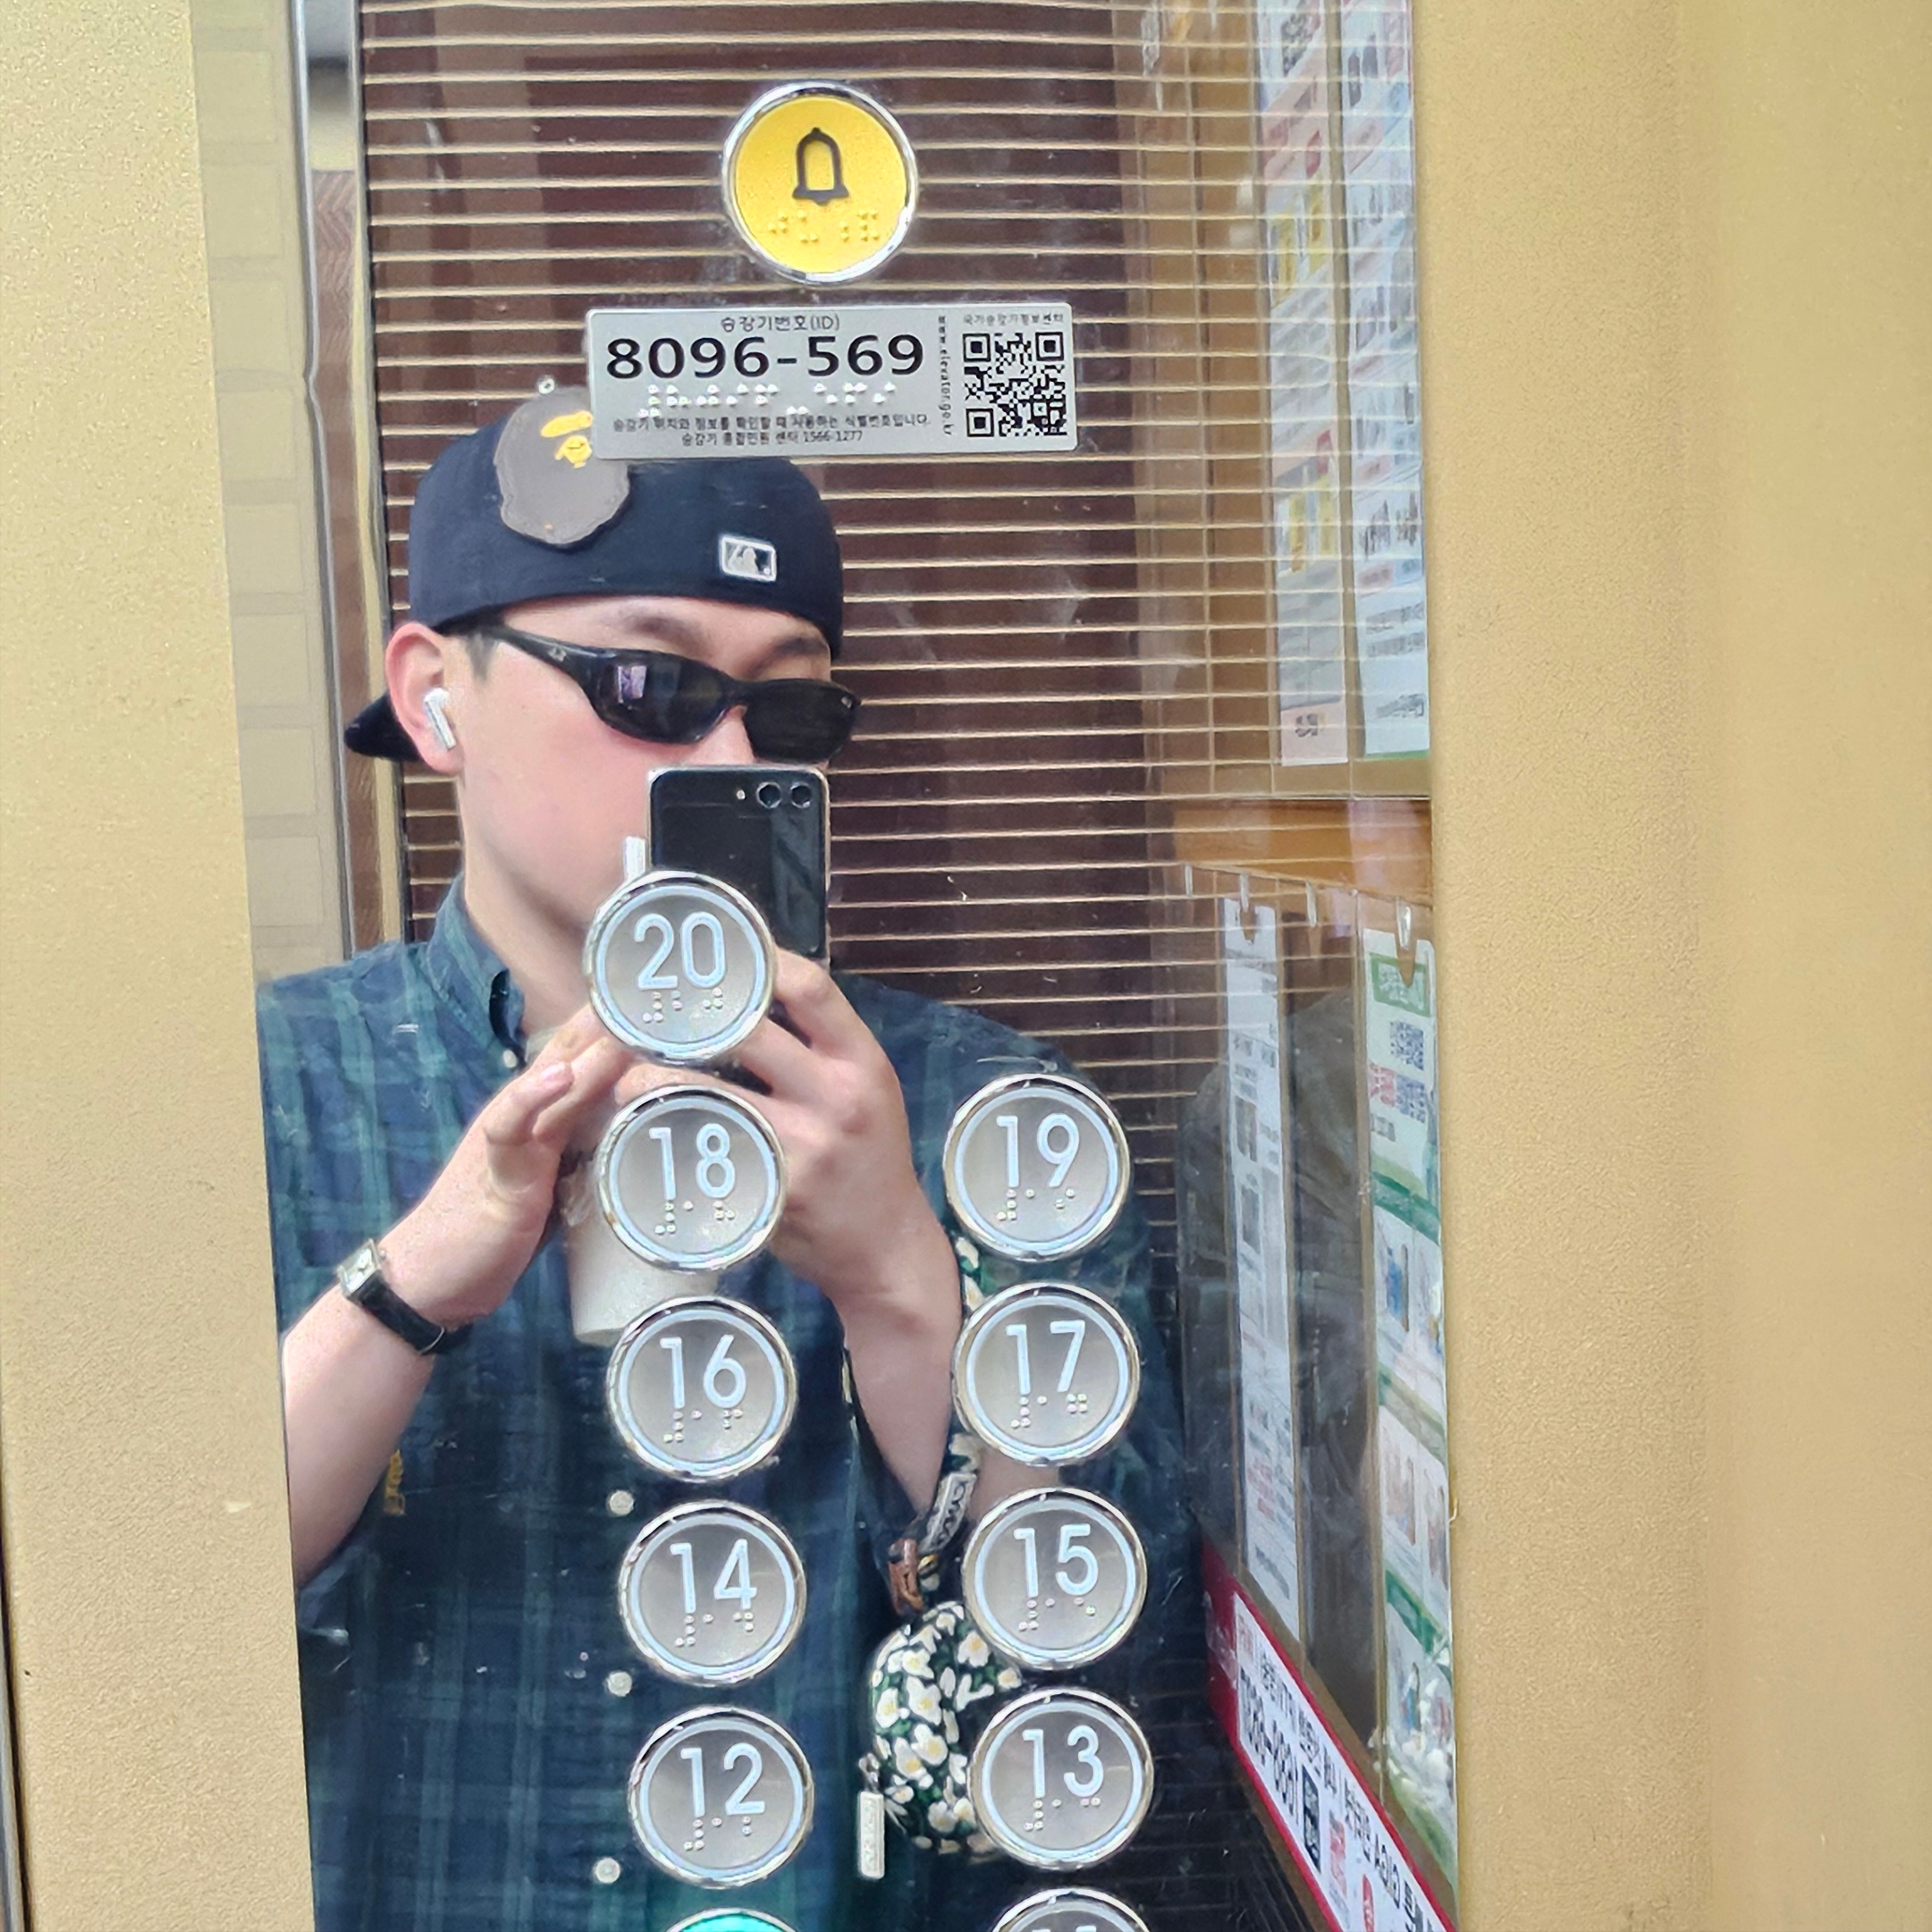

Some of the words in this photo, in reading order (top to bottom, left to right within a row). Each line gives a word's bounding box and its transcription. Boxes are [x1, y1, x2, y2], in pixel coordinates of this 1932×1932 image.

[606, 333, 924, 380] 8096-569
[721, 315, 840, 333] 승강기번호(ID)
[938, 315, 955, 436] www.elevator.go.kr
[613, 417, 650, 433] 승강기
[695, 416, 730, 431] 정보를
[736, 416, 772, 430] 확인할
[792, 414, 839, 429] 사용하는
[681, 433, 719, 448] 승강기
[775, 430, 799, 444] 센터
[803, 429, 864, 443] 1566-1277
[634, 911, 728, 991] 20
[648, 1123, 737, 1200] 18
[996, 1112, 1081, 1188] 19
[660, 1334, 747, 1410] 16
[1006, 1319, 1087, 1395] 17
[670, 1538, 758, 1615] 14
[1013, 1523, 1100, 1599] 15
[680, 1742, 766, 1818] 12
[1022, 1724, 1105, 1799] 13
